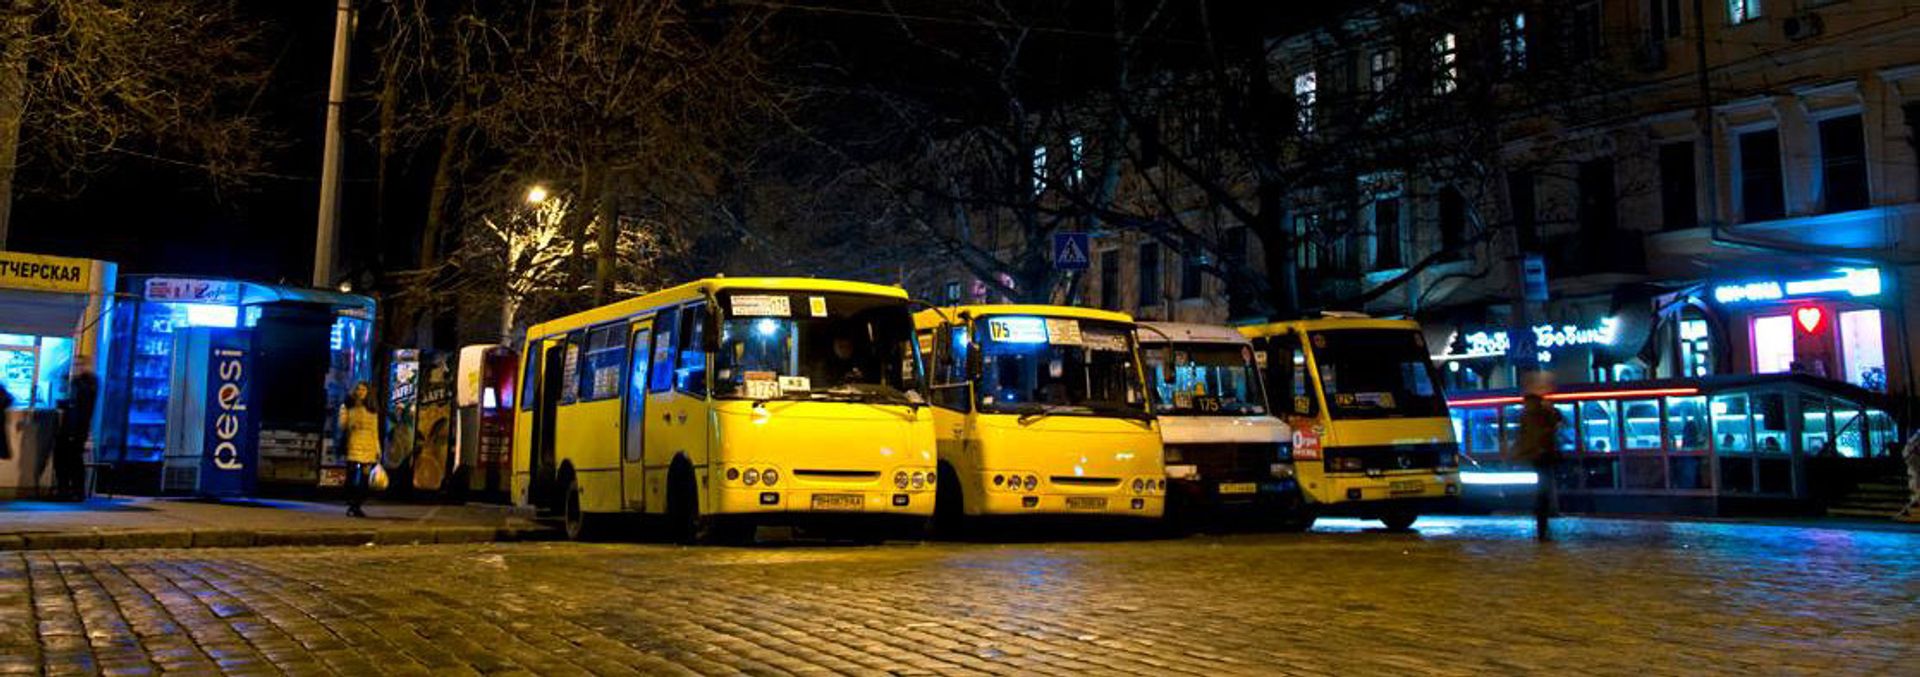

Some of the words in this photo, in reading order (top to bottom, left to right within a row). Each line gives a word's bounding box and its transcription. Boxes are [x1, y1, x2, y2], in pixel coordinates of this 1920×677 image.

[990, 321, 1010, 341] 175
[214, 349, 246, 469] pepsi
[1199, 397, 1219, 411] 175
